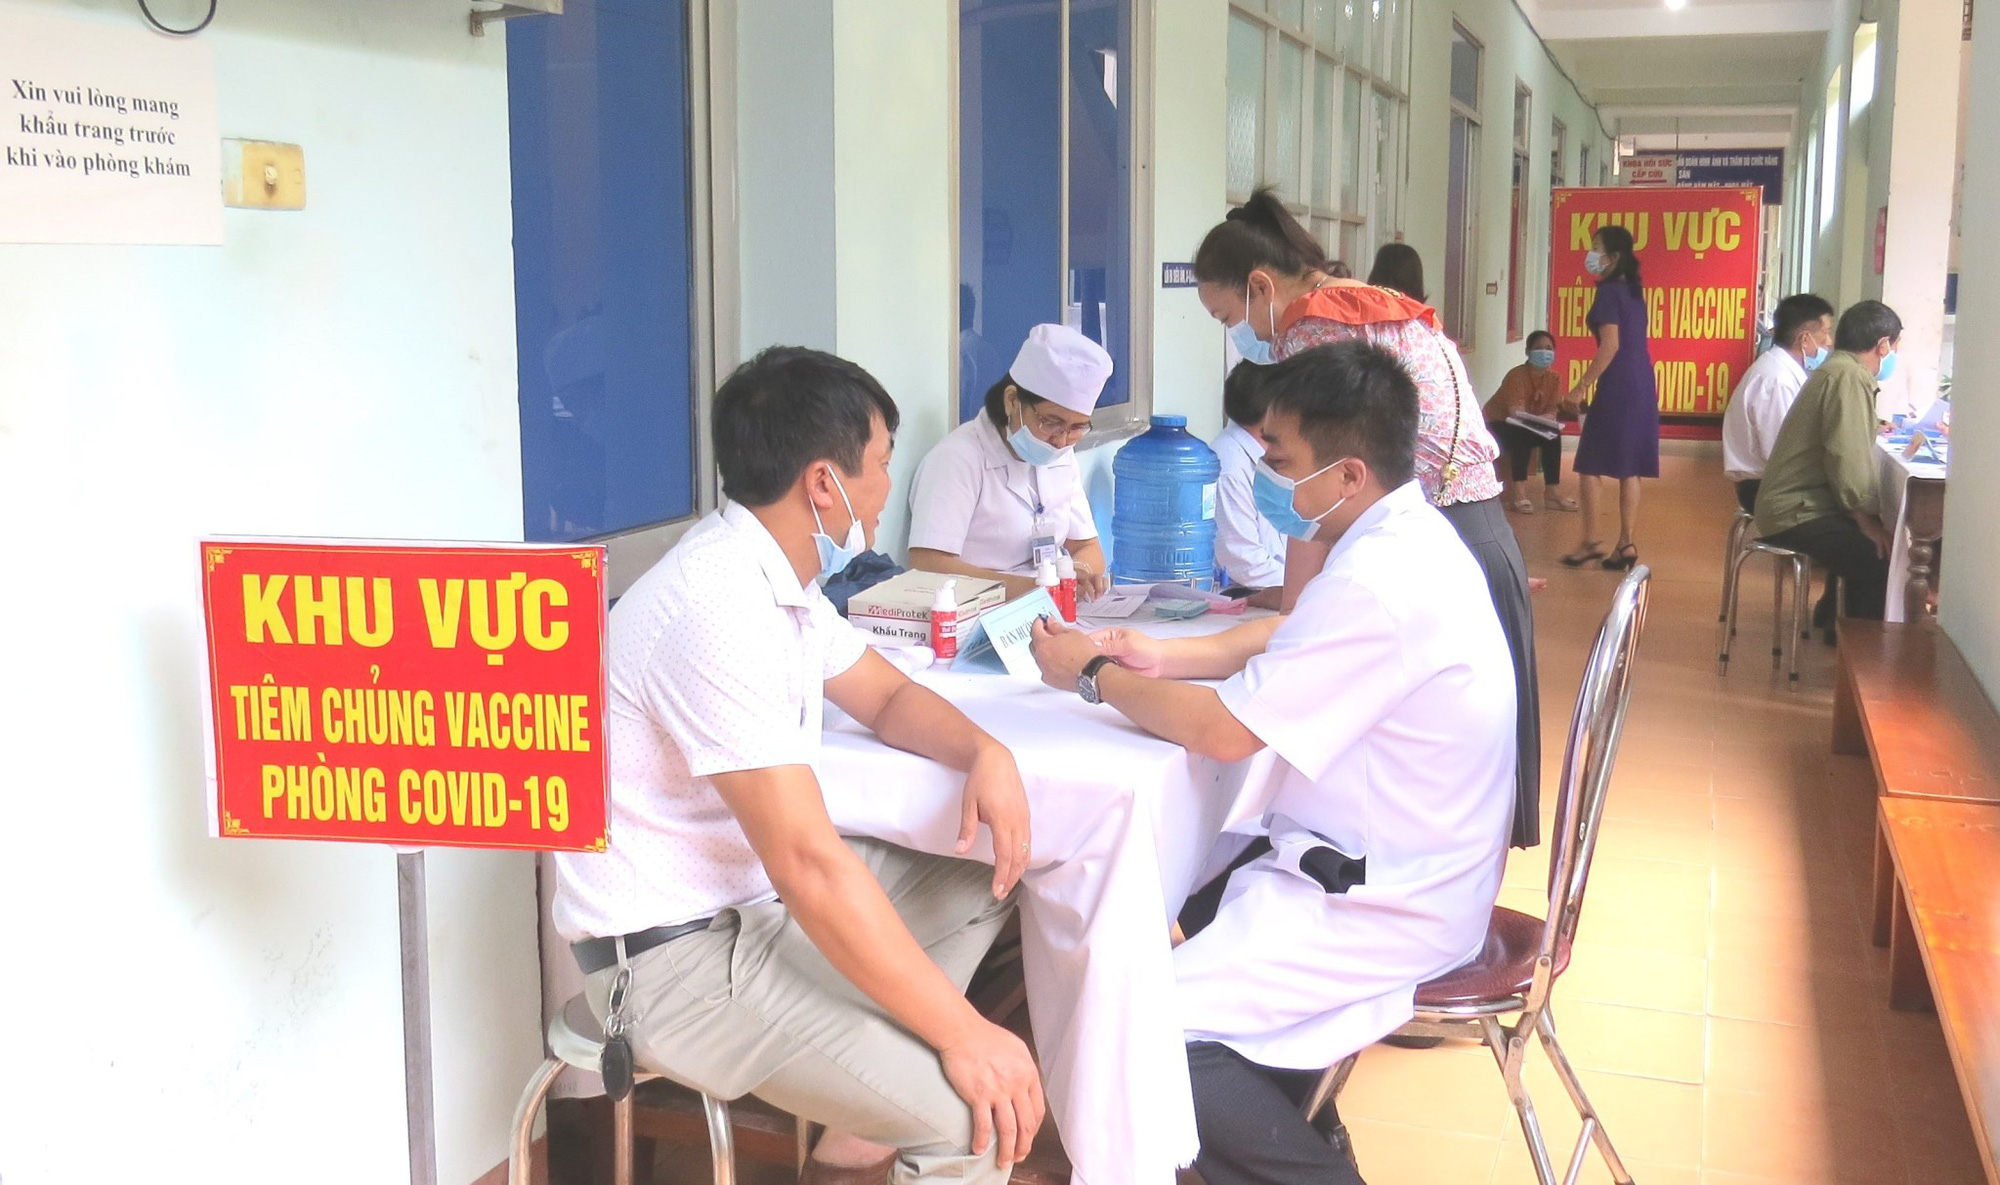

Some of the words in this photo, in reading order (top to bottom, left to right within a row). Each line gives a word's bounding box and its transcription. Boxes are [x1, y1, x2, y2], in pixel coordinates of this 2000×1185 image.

[12, 79, 47, 101] Xin
[53, 86, 82, 105] vui
[88, 87, 127, 114] lòng
[132, 97, 179, 119] mang
[20, 110, 68, 136] khẩu
[75, 121, 125, 146] trang
[130, 126, 175, 145] trước
[7, 146, 38, 167] khi
[44, 149, 77, 170] vào
[83, 152, 140, 179] phòng
[144, 156, 190, 176] khám
[1663, 207, 1741, 259] VỰC
[1669, 287, 1747, 340] VACCINE
[1653, 359, 1729, 414] OVID-19
[241, 573, 394, 648] KHU
[418, 571, 570, 666] VỰC
[868, 605, 928, 620] MediProtek
[899, 628, 927, 641] Trang
[230, 673, 312, 742] TIÊM
[321, 664, 435, 747] CHỦNG
[444, 691, 591, 752] VACCINE
[261, 752, 387, 822] PHÒNG
[398, 769, 570, 832] COVID-19
